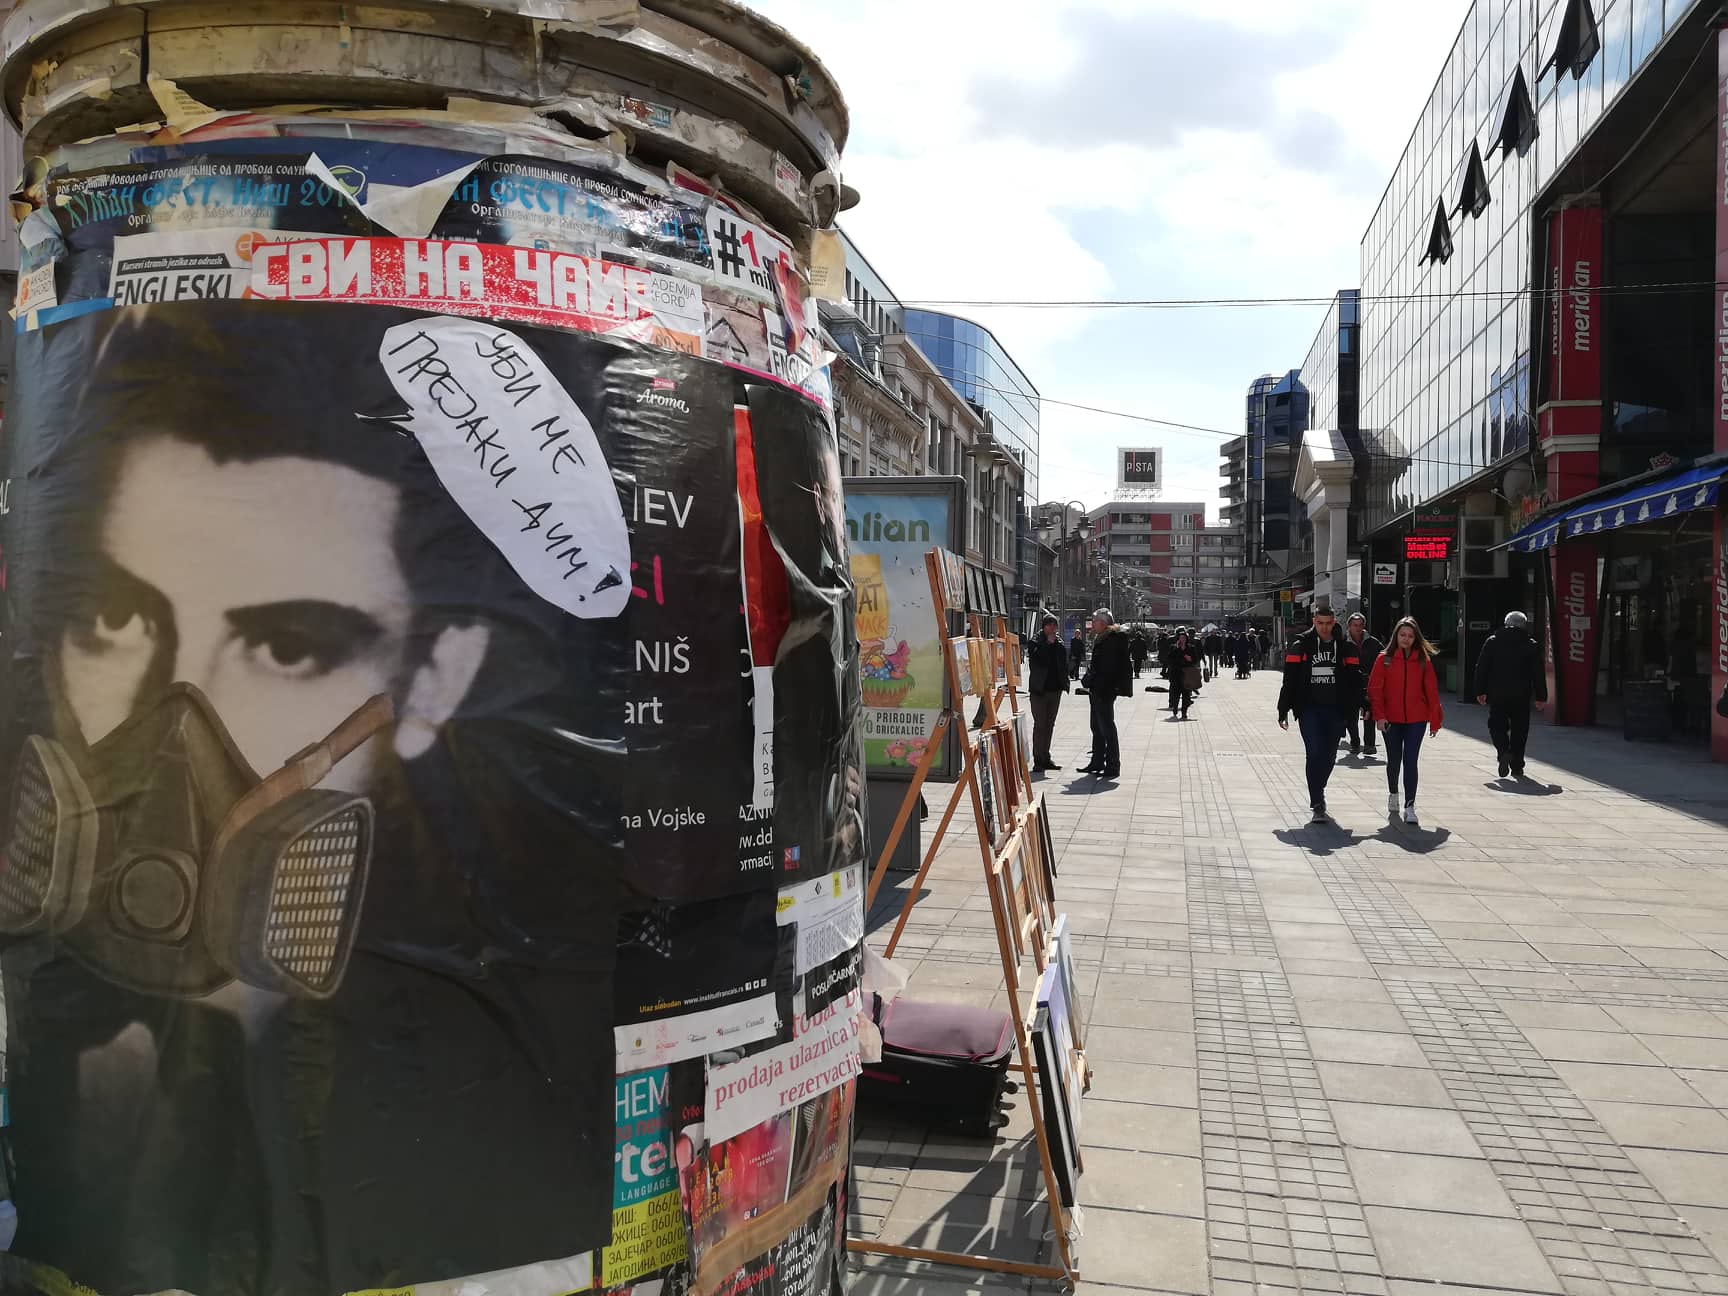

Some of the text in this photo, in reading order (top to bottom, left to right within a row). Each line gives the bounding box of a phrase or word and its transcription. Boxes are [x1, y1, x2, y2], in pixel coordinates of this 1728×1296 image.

[219, 165, 232, 177] ОД
[234, 163, 273, 176] ПРОБОЈА
[570, 175, 583, 188] ОД
[252, 240, 656, 322] СВИ НА ЧАИР
[1569, 260, 1590, 351] meridian
[637, 387, 690, 414] Aroma
[530, 415, 586, 475] МЕ
[1126, 460, 1153, 473] PISTA
[855, 583, 882, 614] AT
[1565, 571, 1585, 662] meidian
[635, 636, 691, 673] NIŠ
[876, 712, 925, 724] PRIRODNE
[876, 725, 925, 736] GRICKALICE
[648, 806, 705, 831] Vojske
[714, 1057, 783, 1110] prodaja
[789, 1026, 849, 1072] ulaznica
[621, 1176, 671, 1201] LANGUAGE
[648, 1191, 681, 1217] 066/4
